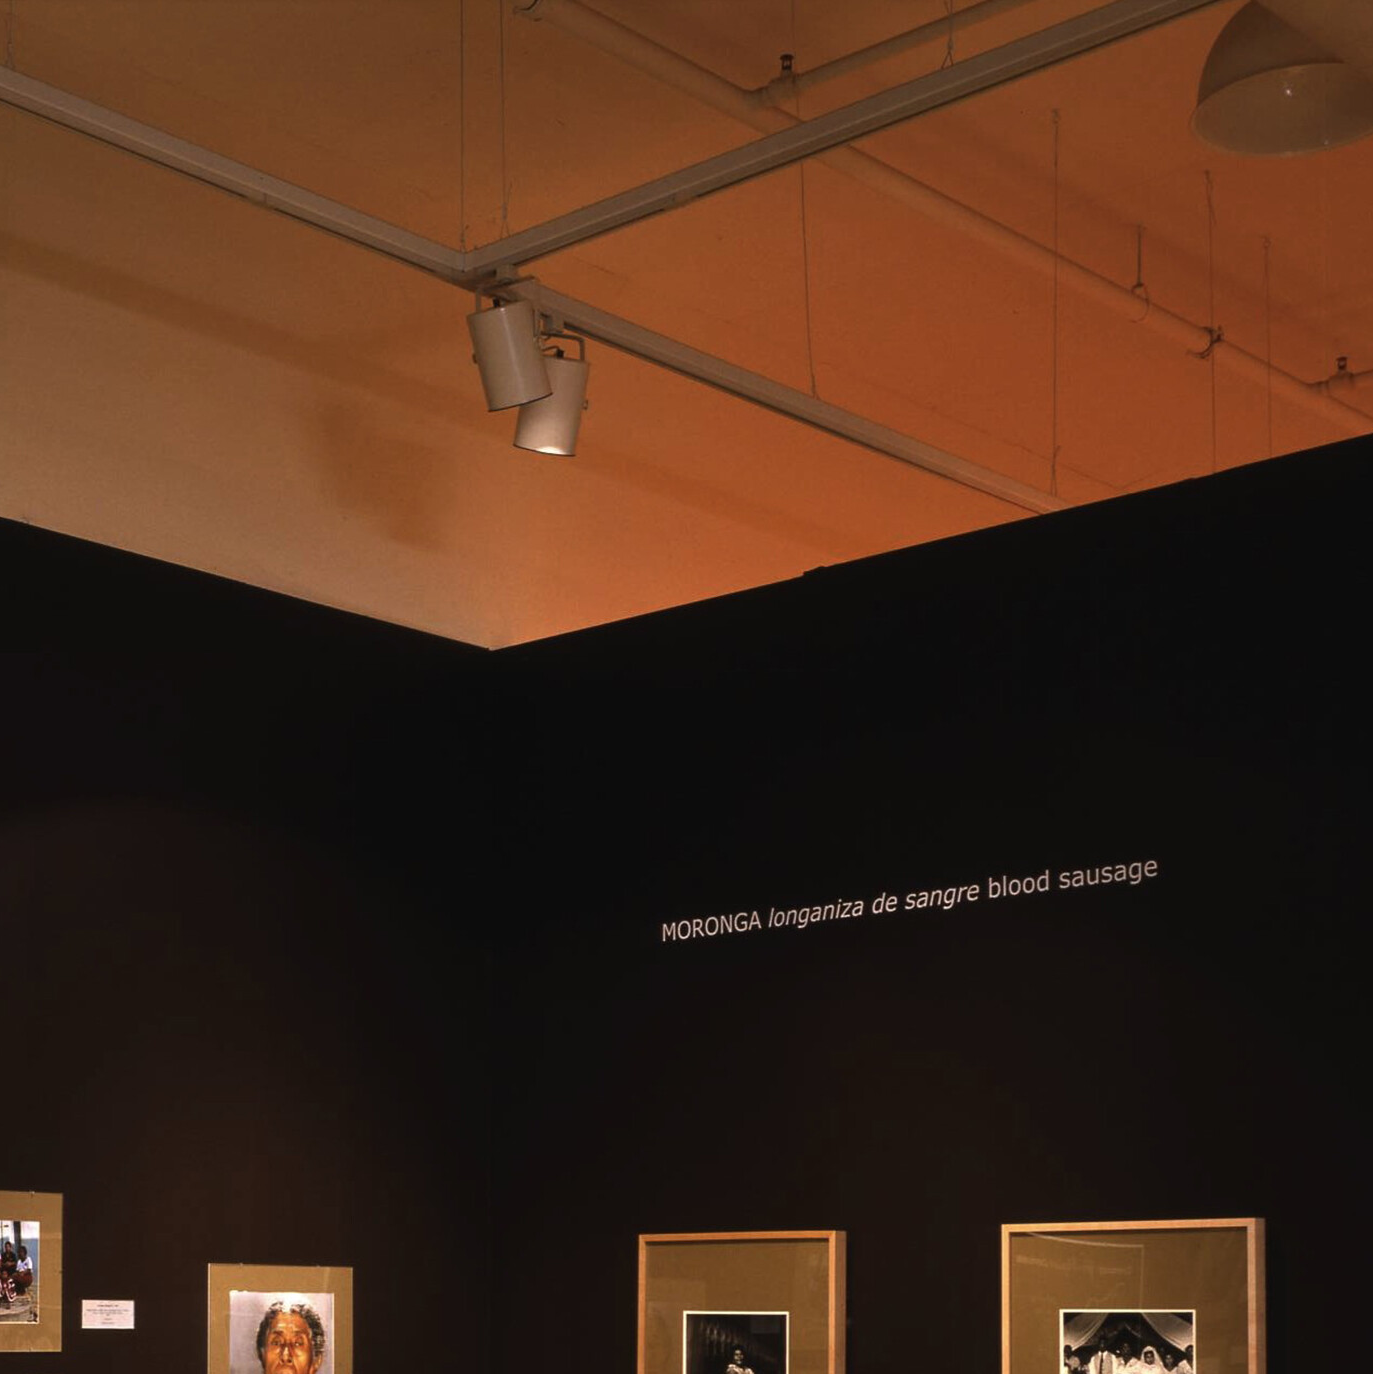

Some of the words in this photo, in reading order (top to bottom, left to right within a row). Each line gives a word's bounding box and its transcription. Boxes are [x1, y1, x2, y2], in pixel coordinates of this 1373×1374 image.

[662, 911, 762, 943] MORONGA
[768, 900, 864, 929] longaniza
[872, 893, 898, 914] de
[904, 882, 979, 911] sangre
[988, 870, 1050, 899] blood
[1059, 859, 1159, 890] sausage
